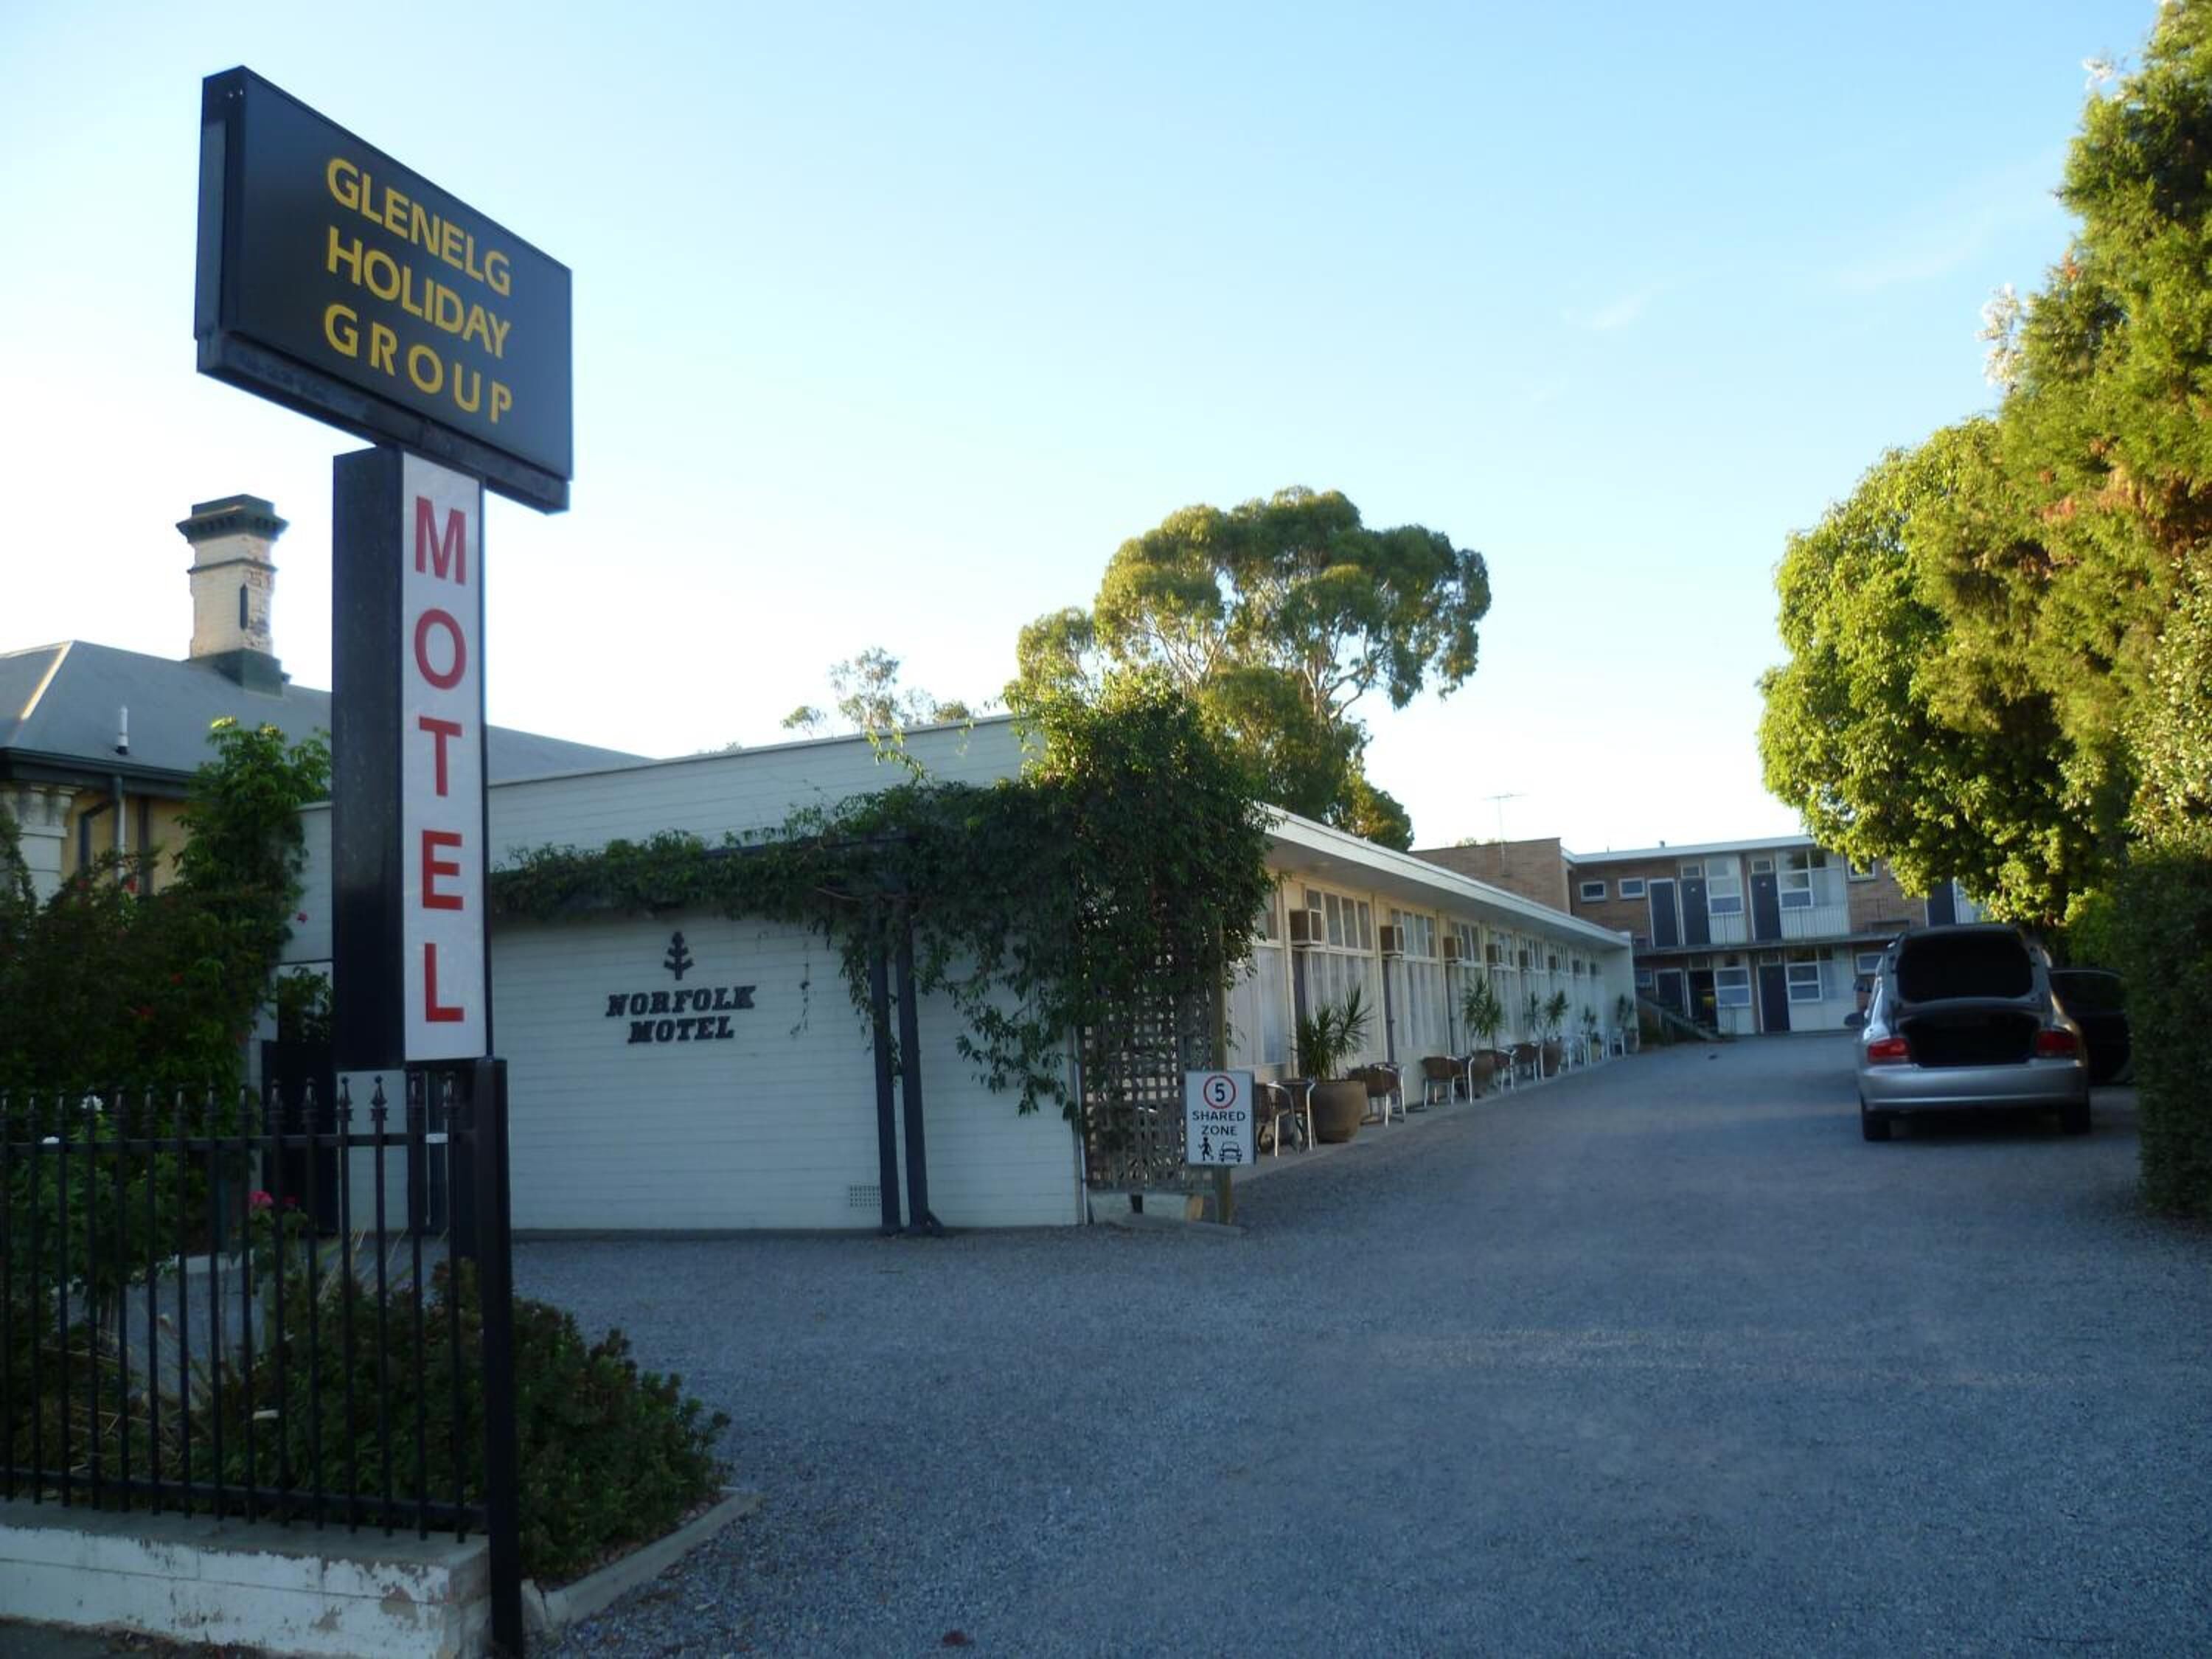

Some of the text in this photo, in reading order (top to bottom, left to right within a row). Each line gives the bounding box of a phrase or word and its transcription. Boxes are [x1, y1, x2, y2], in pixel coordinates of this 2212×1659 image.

[327, 157, 510, 296] GLENELG
[327, 226, 510, 358] HOLIDAY
[324, 303, 512, 423] GROUP
[414, 495, 467, 1023] MOTEL
[605, 985, 757, 1017] NORFOLK
[627, 1015, 734, 1044] MOTEL
[1214, 1082, 1225, 1102] 5
[1192, 1110, 1246, 1121] SHARED
[1201, 1124, 1239, 1135] ZONE
